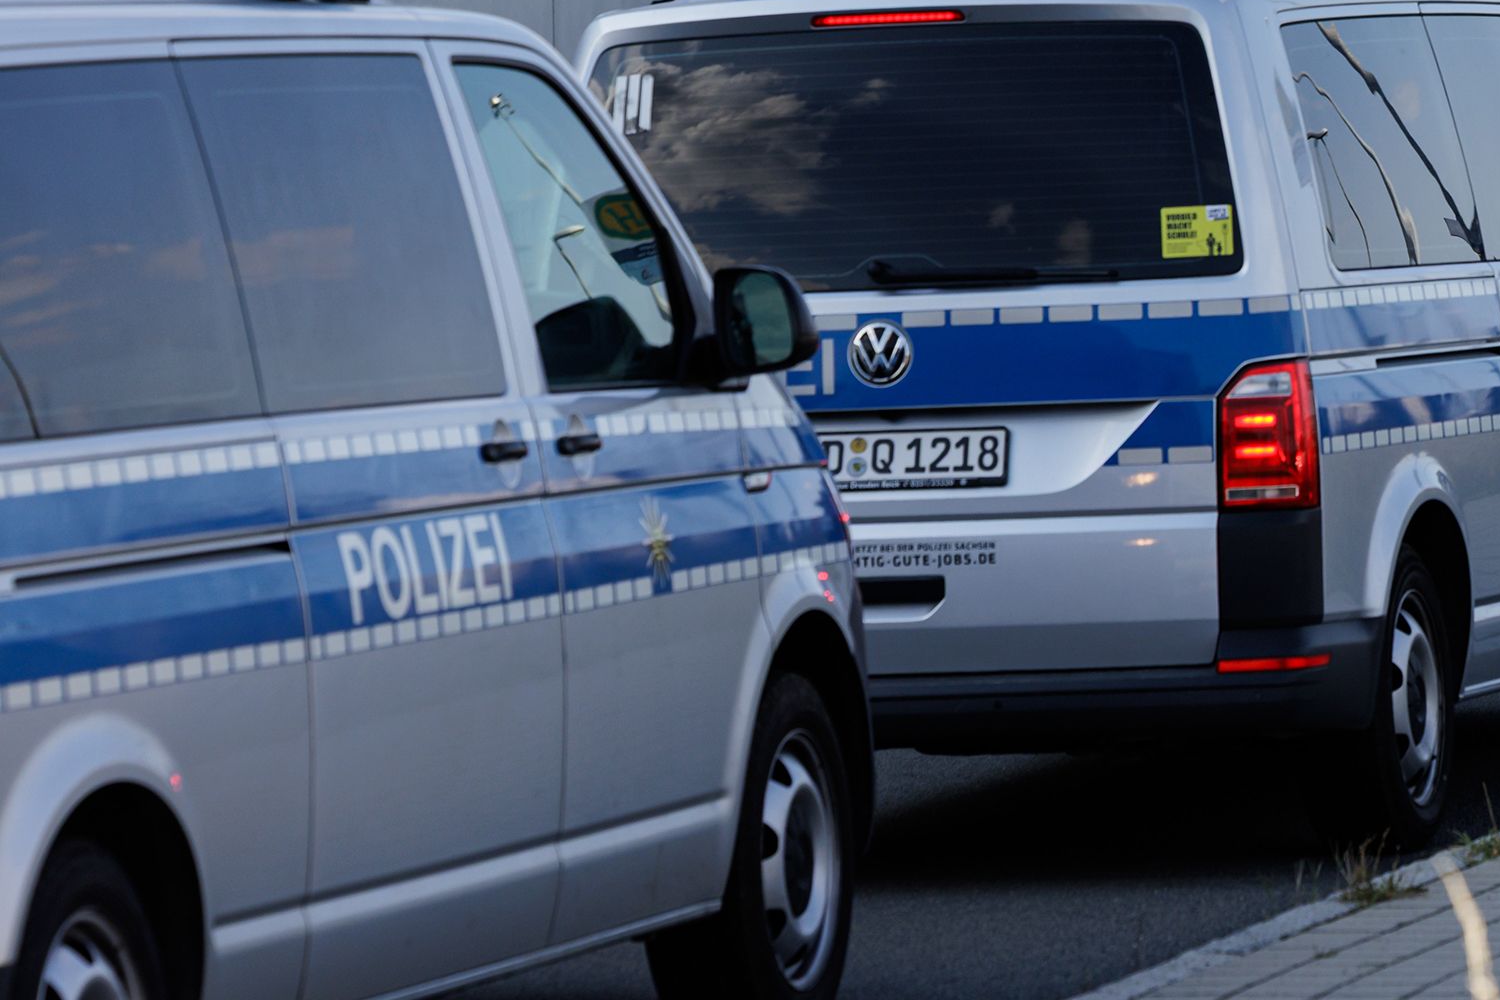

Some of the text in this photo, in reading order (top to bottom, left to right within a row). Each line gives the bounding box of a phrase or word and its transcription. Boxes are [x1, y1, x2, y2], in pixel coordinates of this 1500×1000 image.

[851, 322, 910, 384] VW
[872, 439, 894, 474] Q
[904, 436, 998, 473] 1218
[337, 511, 514, 626] POLIZEI
[917, 542, 951, 552] POLIZEI
[954, 541, 995, 550] SACHSEN
